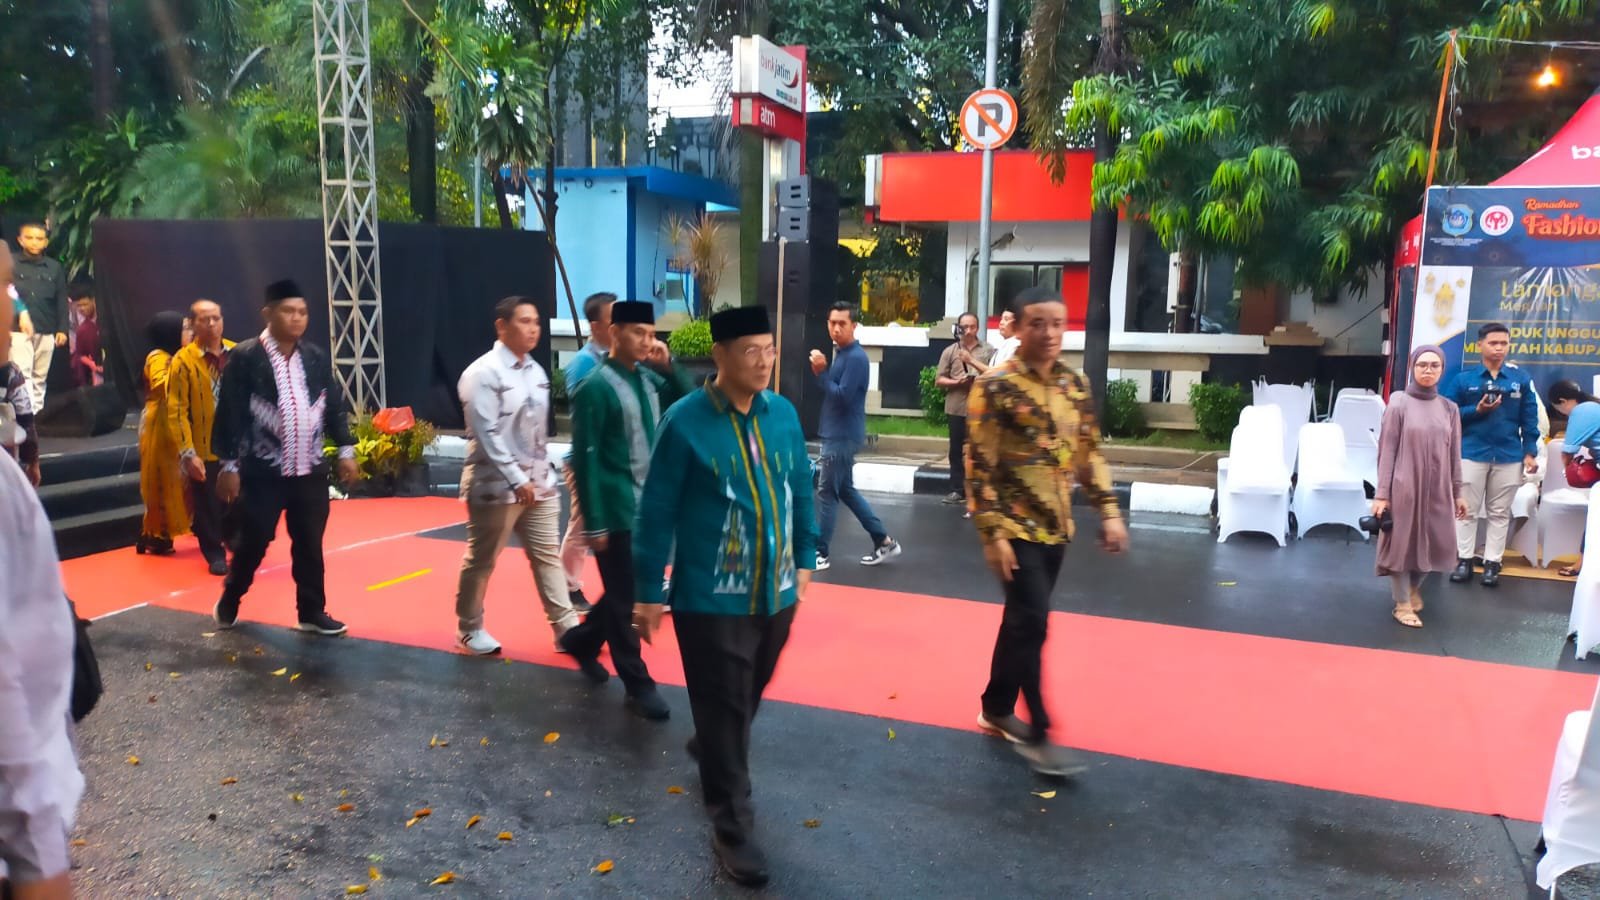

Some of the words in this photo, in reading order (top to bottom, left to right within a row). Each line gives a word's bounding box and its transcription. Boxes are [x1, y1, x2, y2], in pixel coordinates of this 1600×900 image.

[760, 105, 776, 129] atm
[977, 103, 1003, 137] P
[1524, 198, 1580, 210] Ramadhan
[1522, 213, 1600, 238] Fashio
[1501, 281, 1600, 304] Lamong
